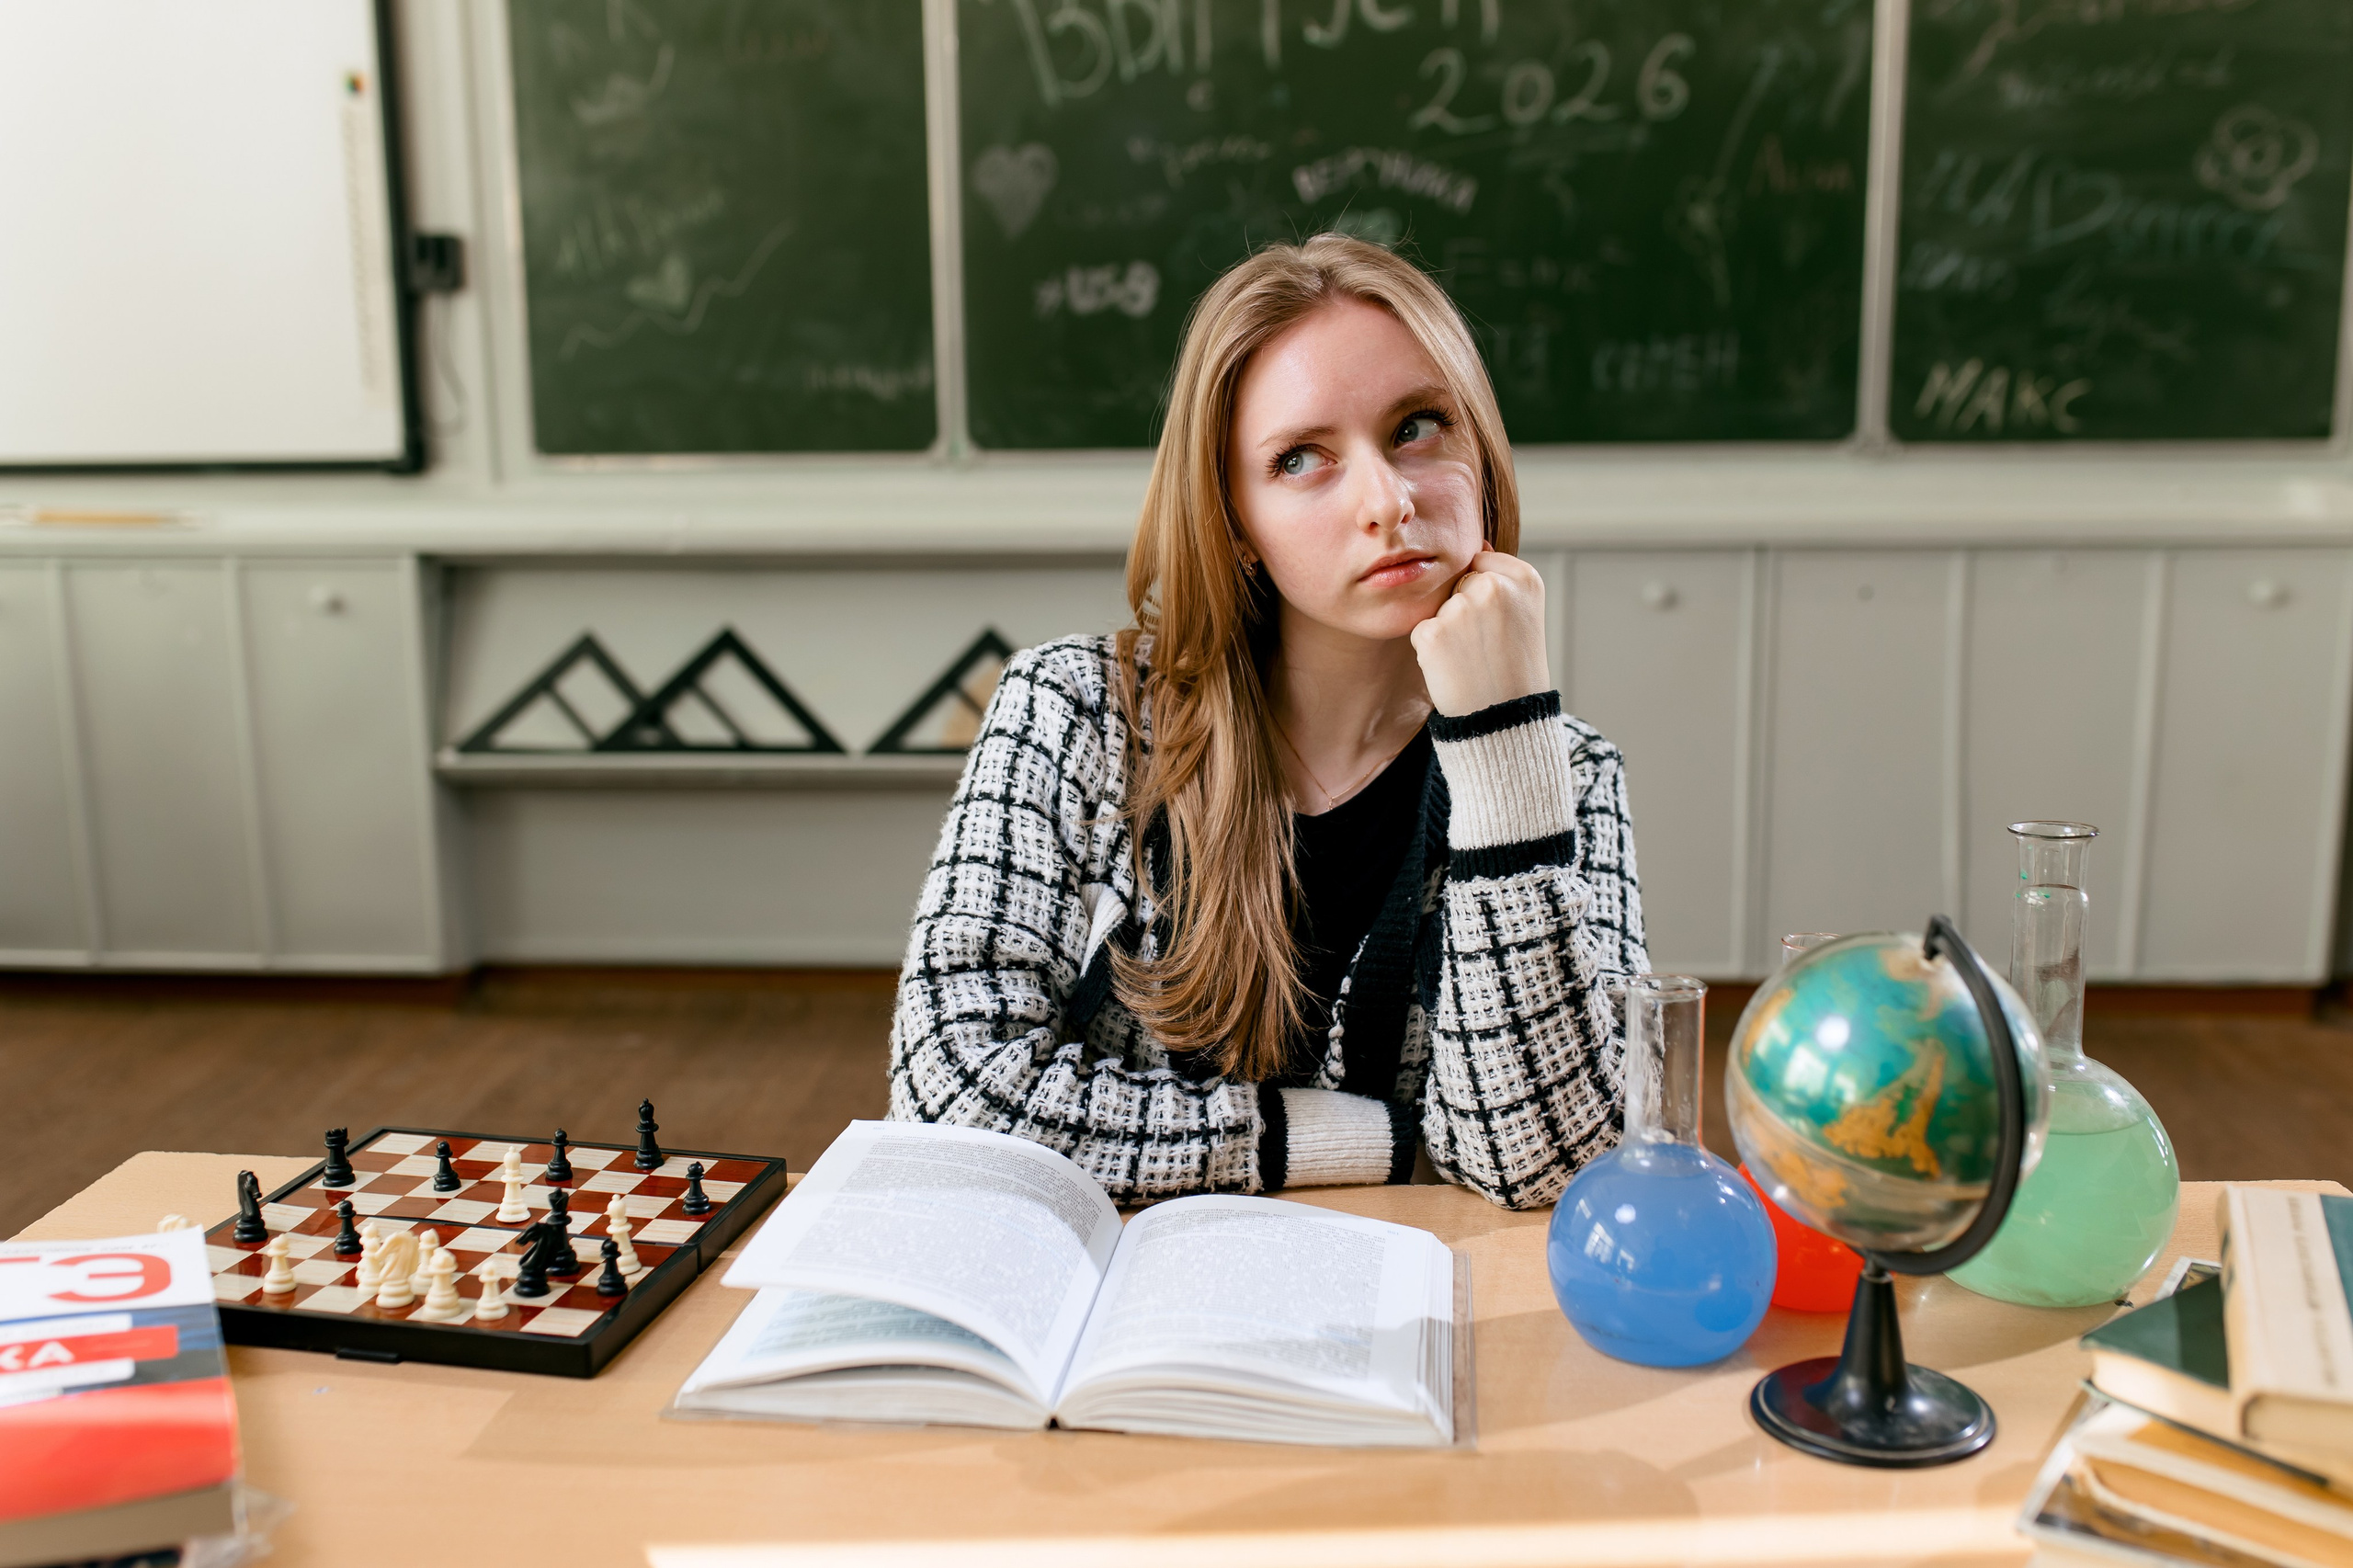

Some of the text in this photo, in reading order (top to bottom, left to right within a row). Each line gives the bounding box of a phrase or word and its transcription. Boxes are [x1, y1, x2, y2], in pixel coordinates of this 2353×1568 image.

[1408, 34, 1696, 135] 2026
[1913, 357, 2093, 435] МАКС
[0, 1252, 172, 1304] Э
